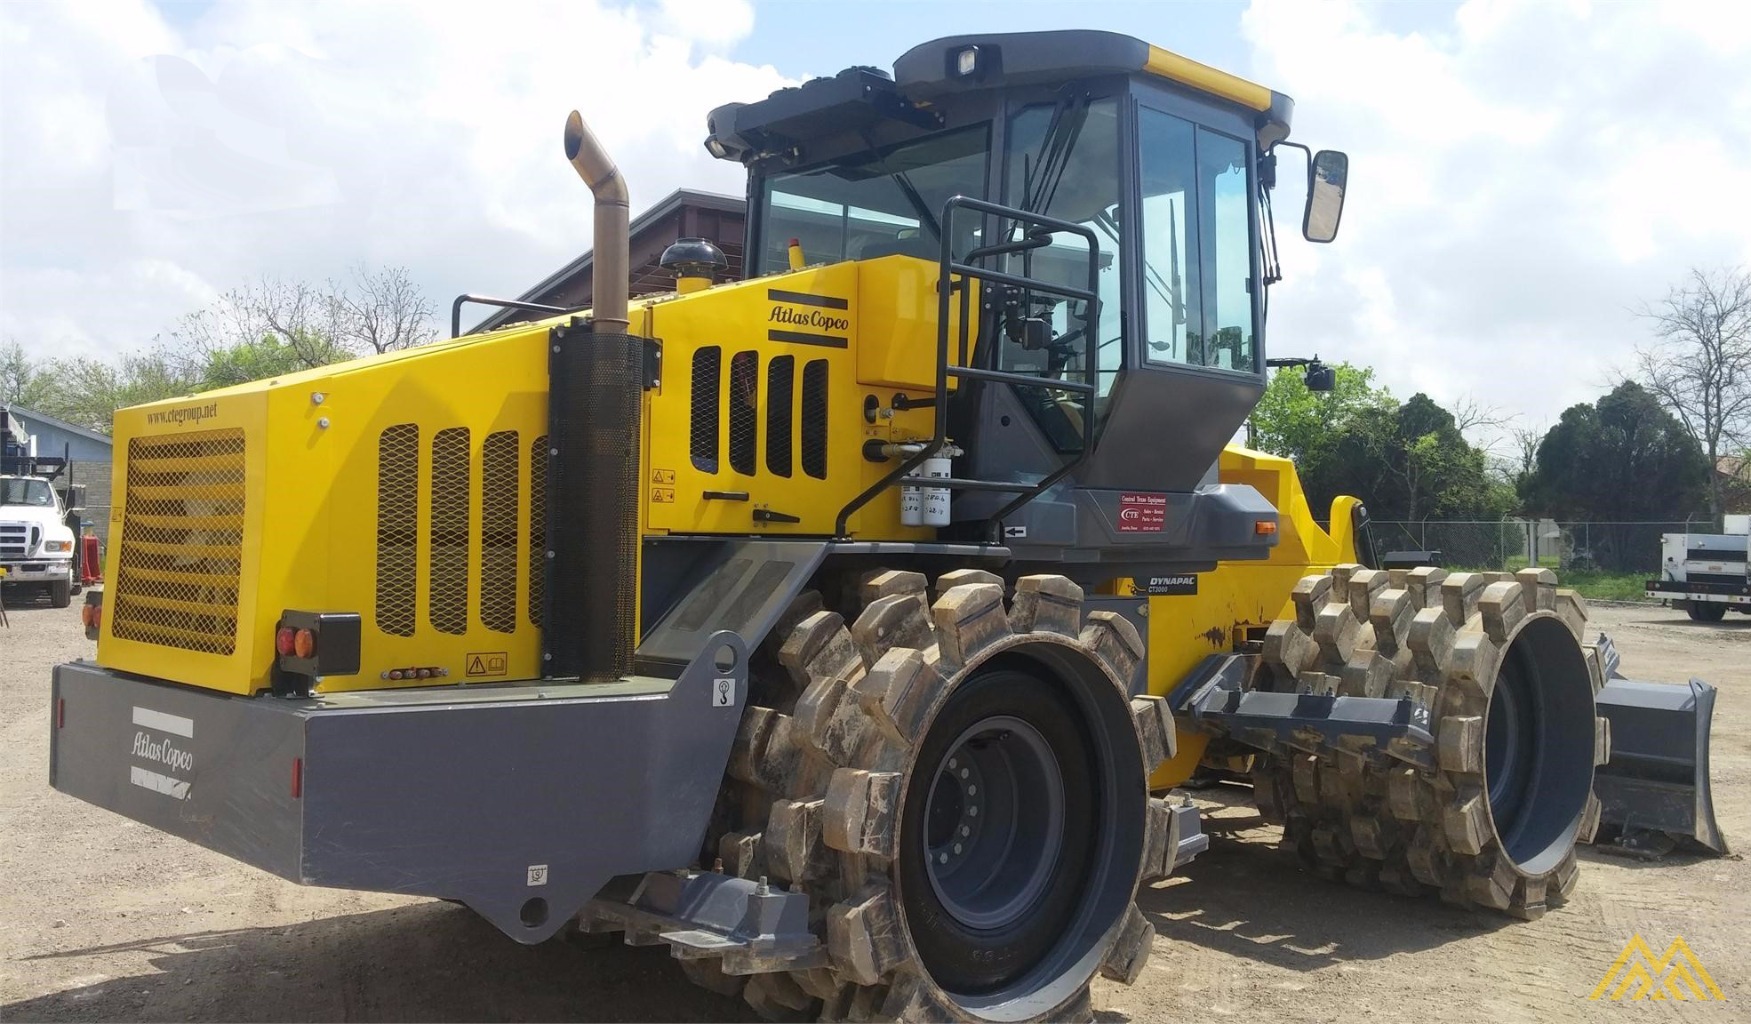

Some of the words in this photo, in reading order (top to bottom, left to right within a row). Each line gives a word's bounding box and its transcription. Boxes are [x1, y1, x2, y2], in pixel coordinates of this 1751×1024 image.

[768, 305, 809, 326] Atlas
[811, 310, 849, 332] Copco
[147, 401, 217, 427] www.ctegroup.net
[1150, 576, 1195, 585] DYNAPAC
[131, 731, 161, 762] Atlas
[162, 738, 193, 772] Copco
